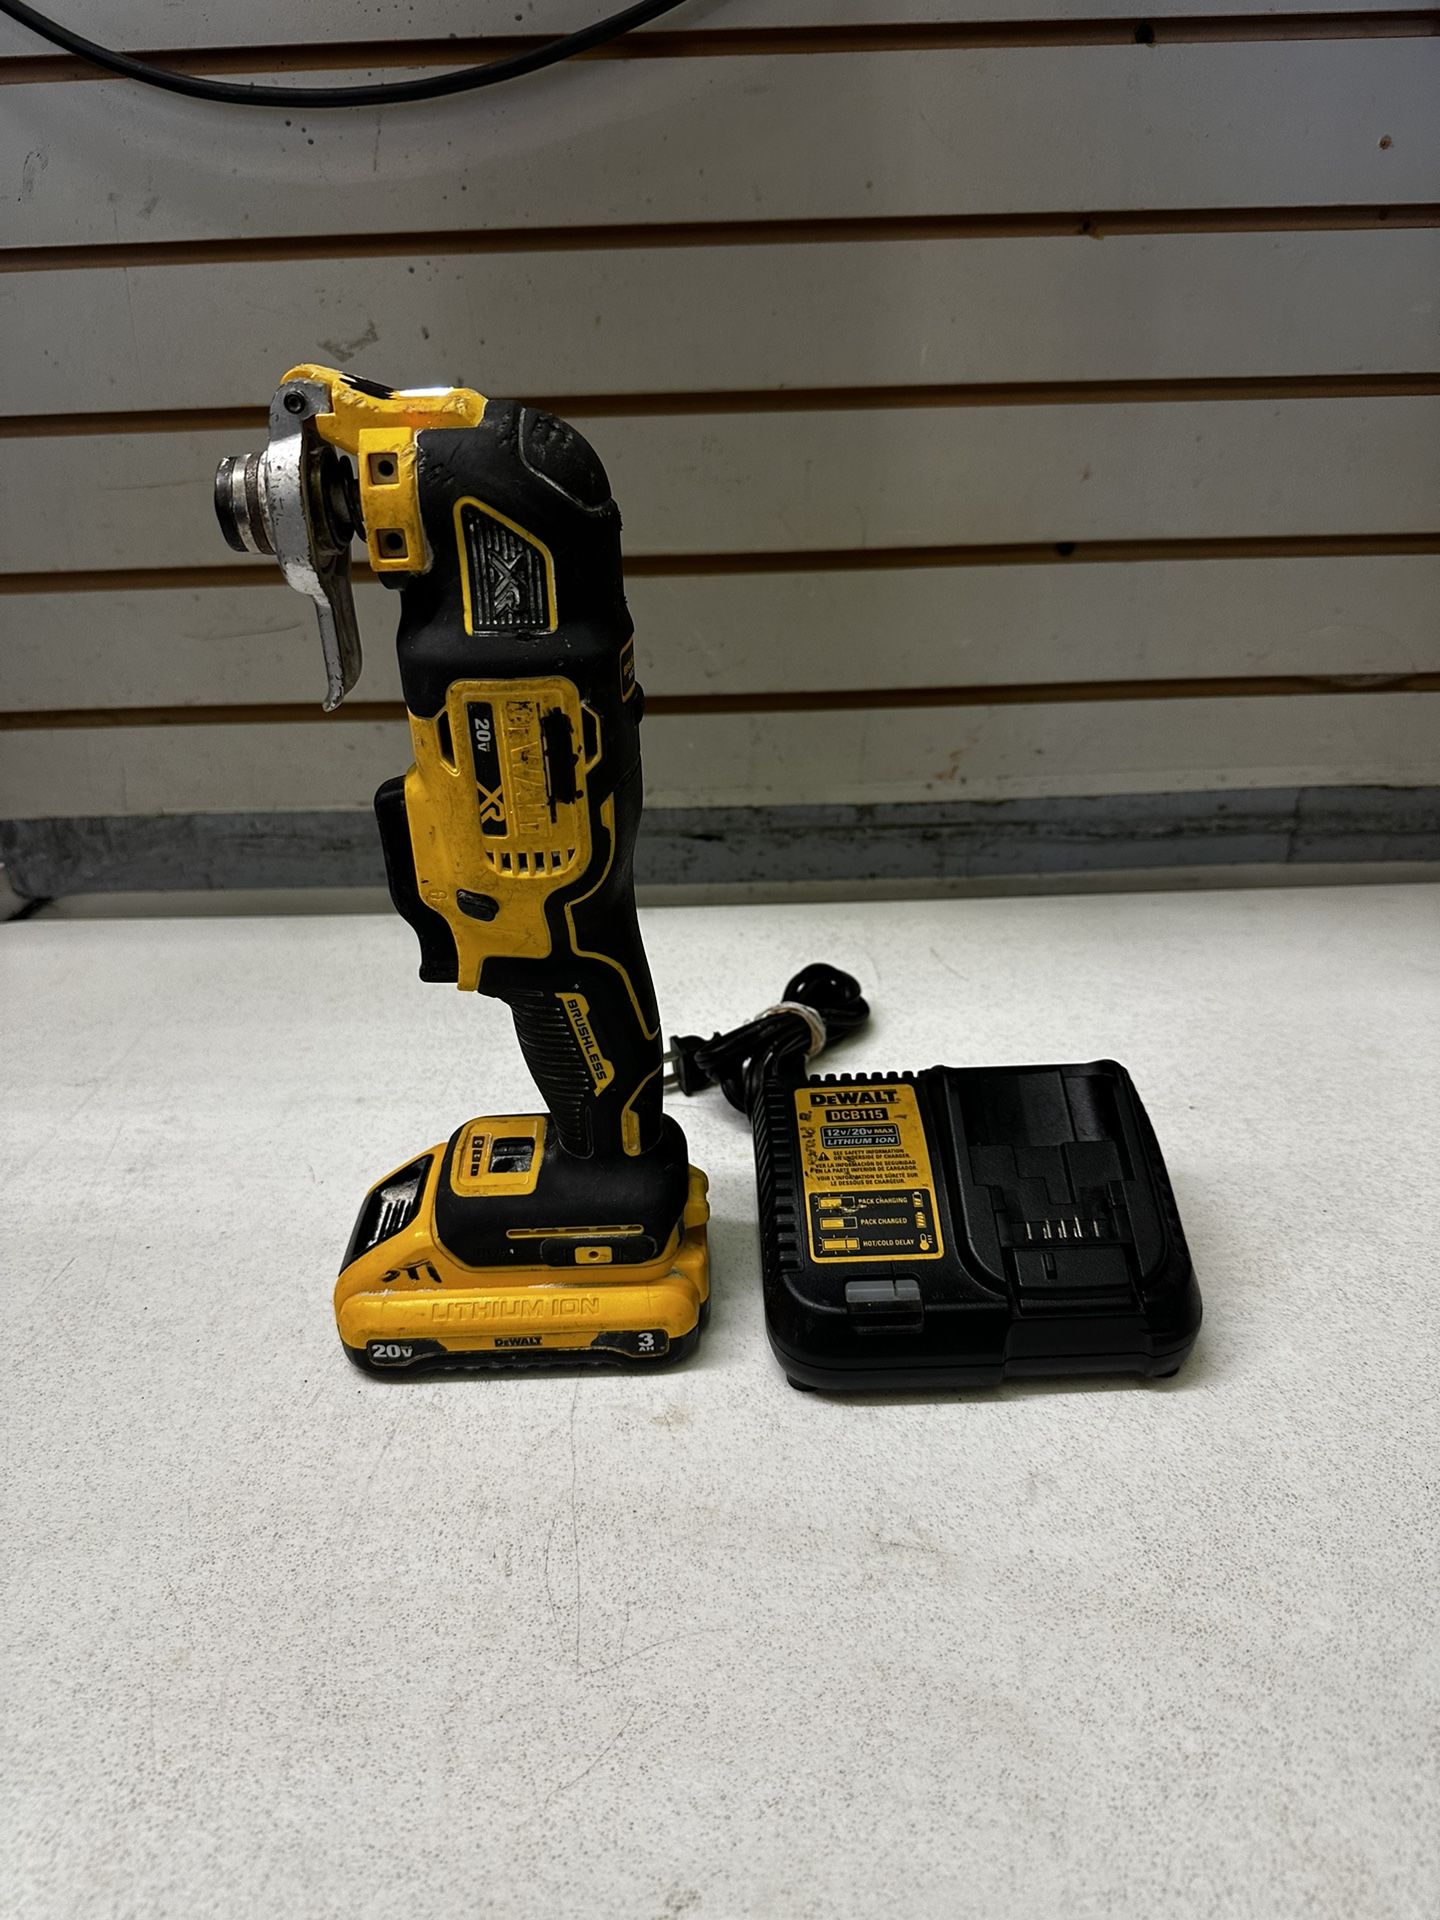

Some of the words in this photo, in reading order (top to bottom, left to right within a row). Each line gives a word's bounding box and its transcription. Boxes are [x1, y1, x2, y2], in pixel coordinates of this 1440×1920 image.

[477, 781, 506, 824] XR
[567, 999, 607, 1080] BRUSHLESS
[830, 1110, 884, 1121] DCB115
[826, 1137, 872, 1146] LITHIUM
[875, 1136, 896, 1144] ION
[878, 1217, 908, 1225] CHARGED
[862, 1239, 894, 1247] HOT/COLD
[894, 1238, 915, 1246] DELAY
[431, 1299, 545, 1322] LITHIUM
[551, 1297, 600, 1317] ION
[637, 1332, 655, 1347] 3
